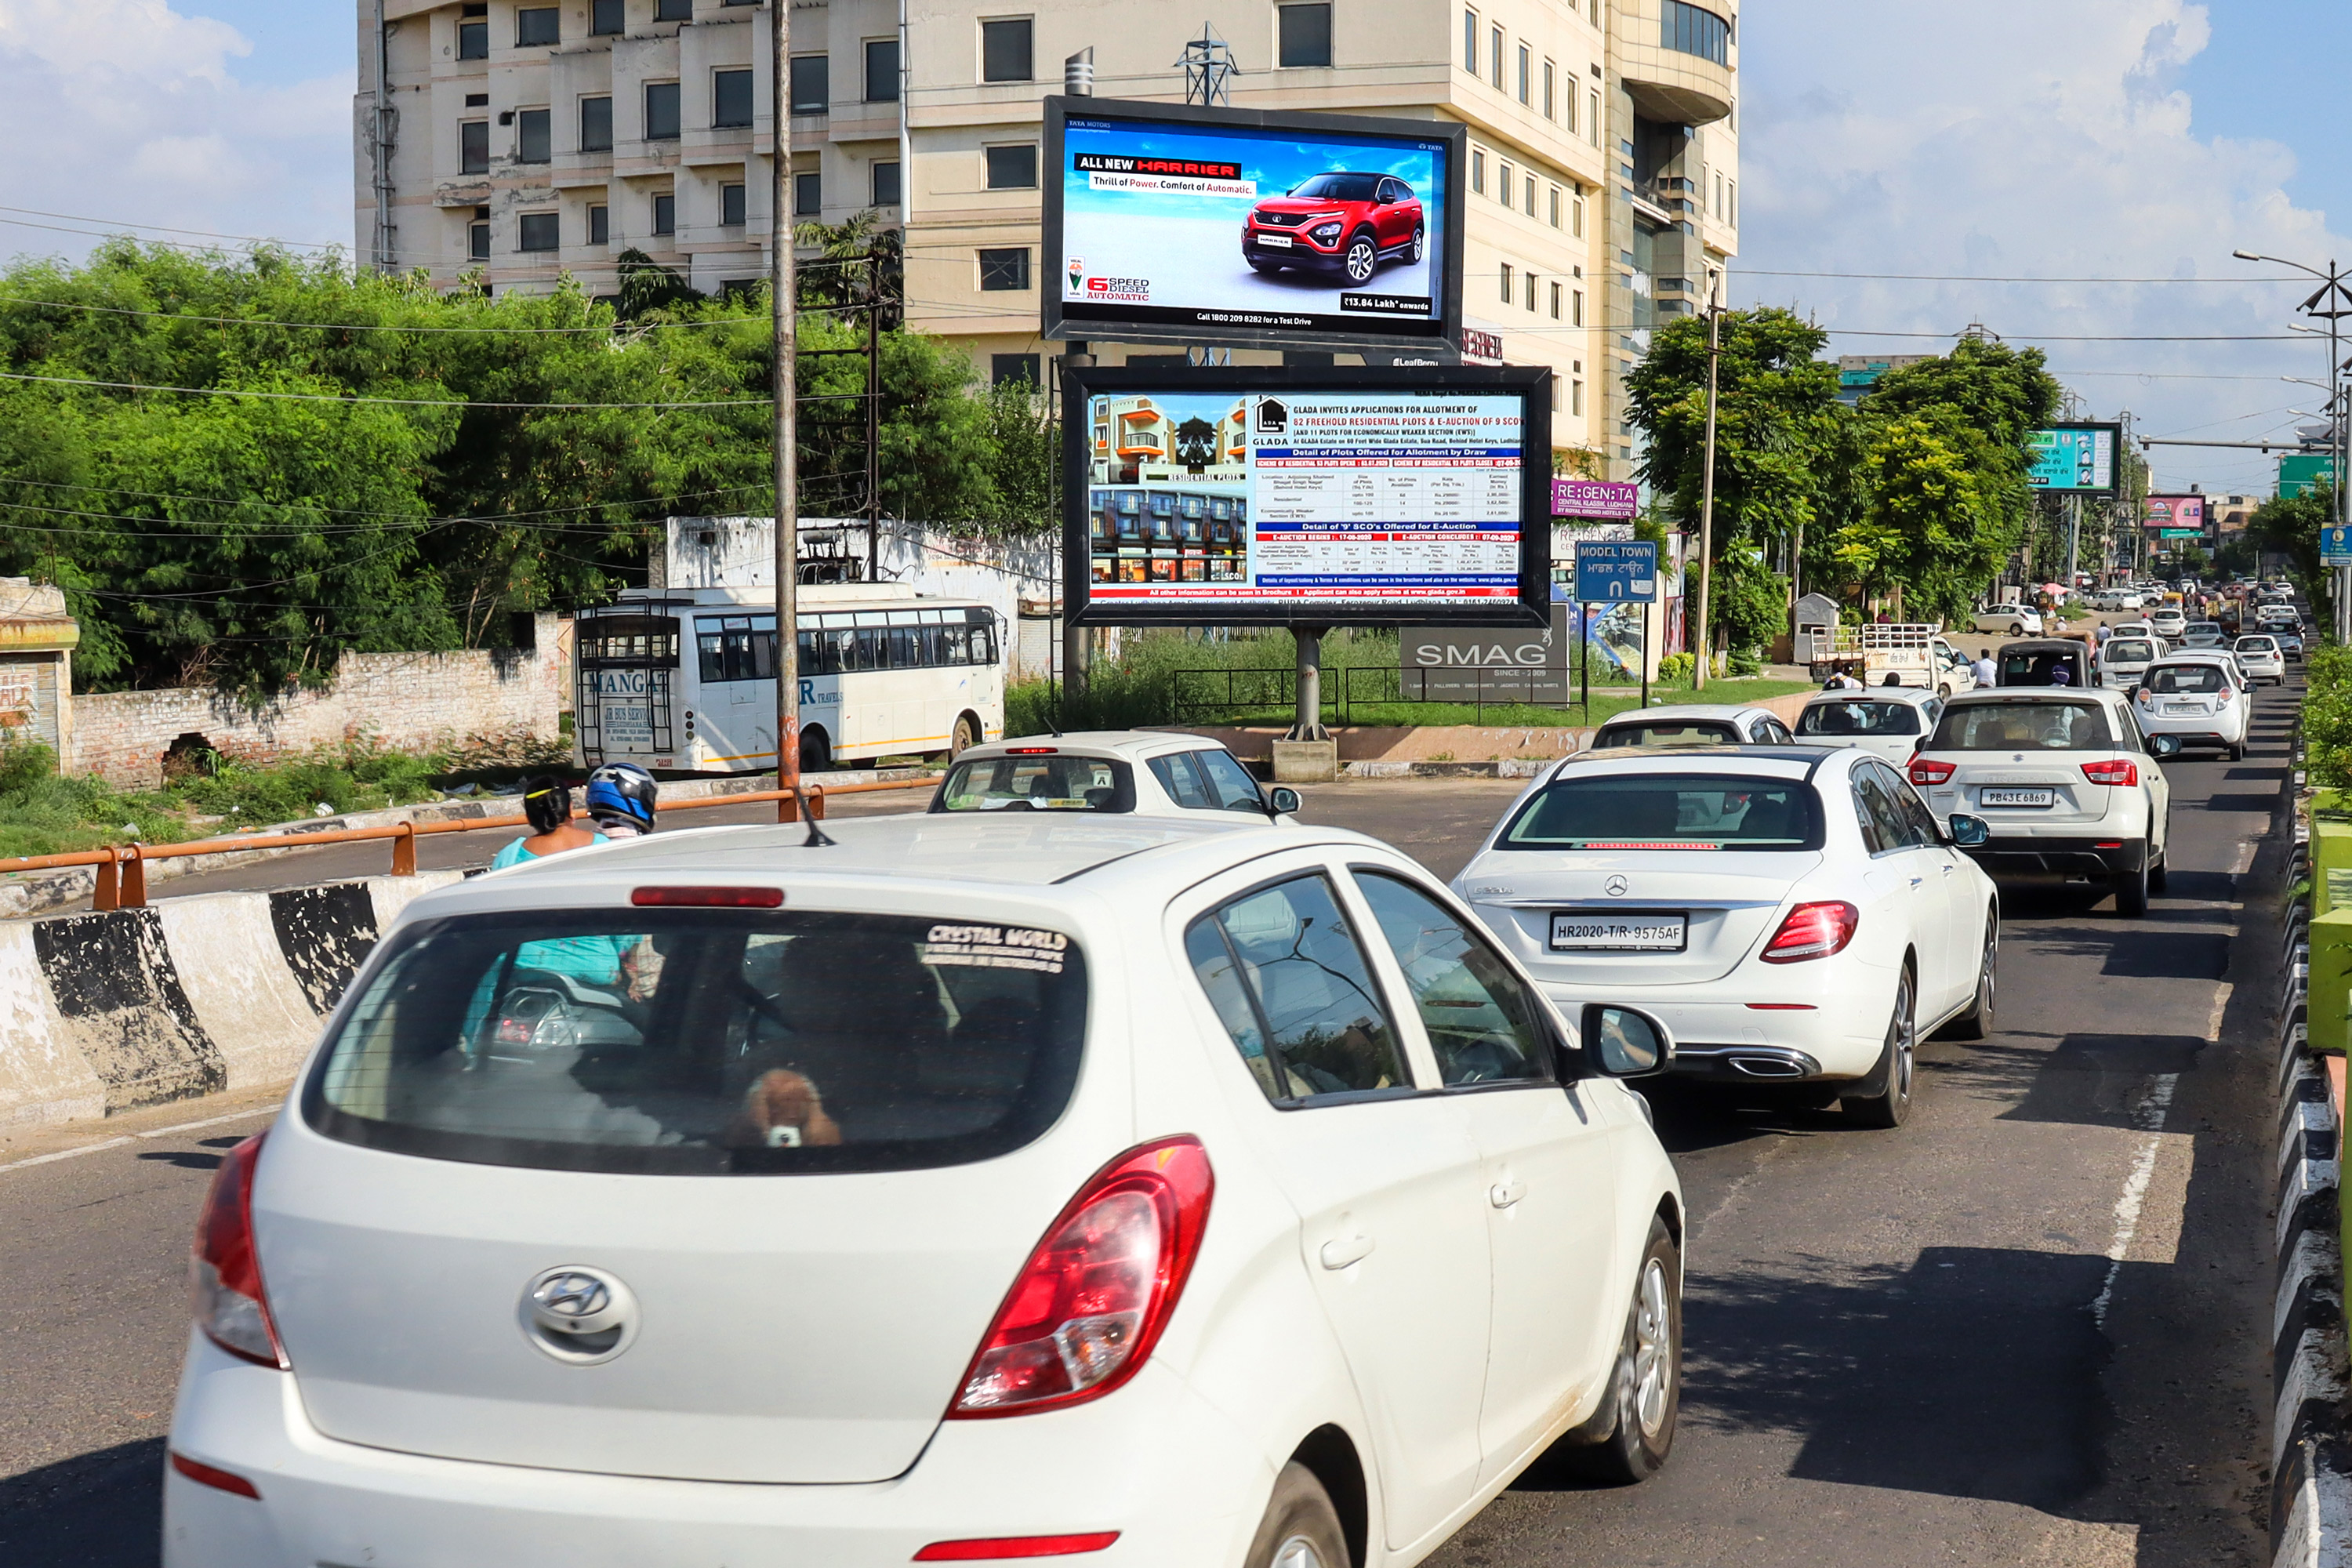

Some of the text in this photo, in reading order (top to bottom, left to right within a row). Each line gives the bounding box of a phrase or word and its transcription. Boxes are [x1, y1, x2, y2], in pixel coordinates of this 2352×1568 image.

[1080, 157, 1235, 176] ALL NEW HARRIER
[1094, 177, 1252, 194] Thrill of Power. Comfort of Automatic.
[1087, 278, 1149, 292] 6 SPEED
[1087, 292, 1149, 301] AUTOMATIC
[1399, 301, 1428, 310] onwards
[1196, 312, 1210, 321] Call
[1581, 547, 1651, 557] MODEL TOWN
[1587, 564, 1613, 574] ਮਾਡਲ
[1416, 644, 1546, 666] SMAG
[800, 679, 844, 704] R TRAVELS
[927, 925, 1068, 950] CRYSTAL WORLD
